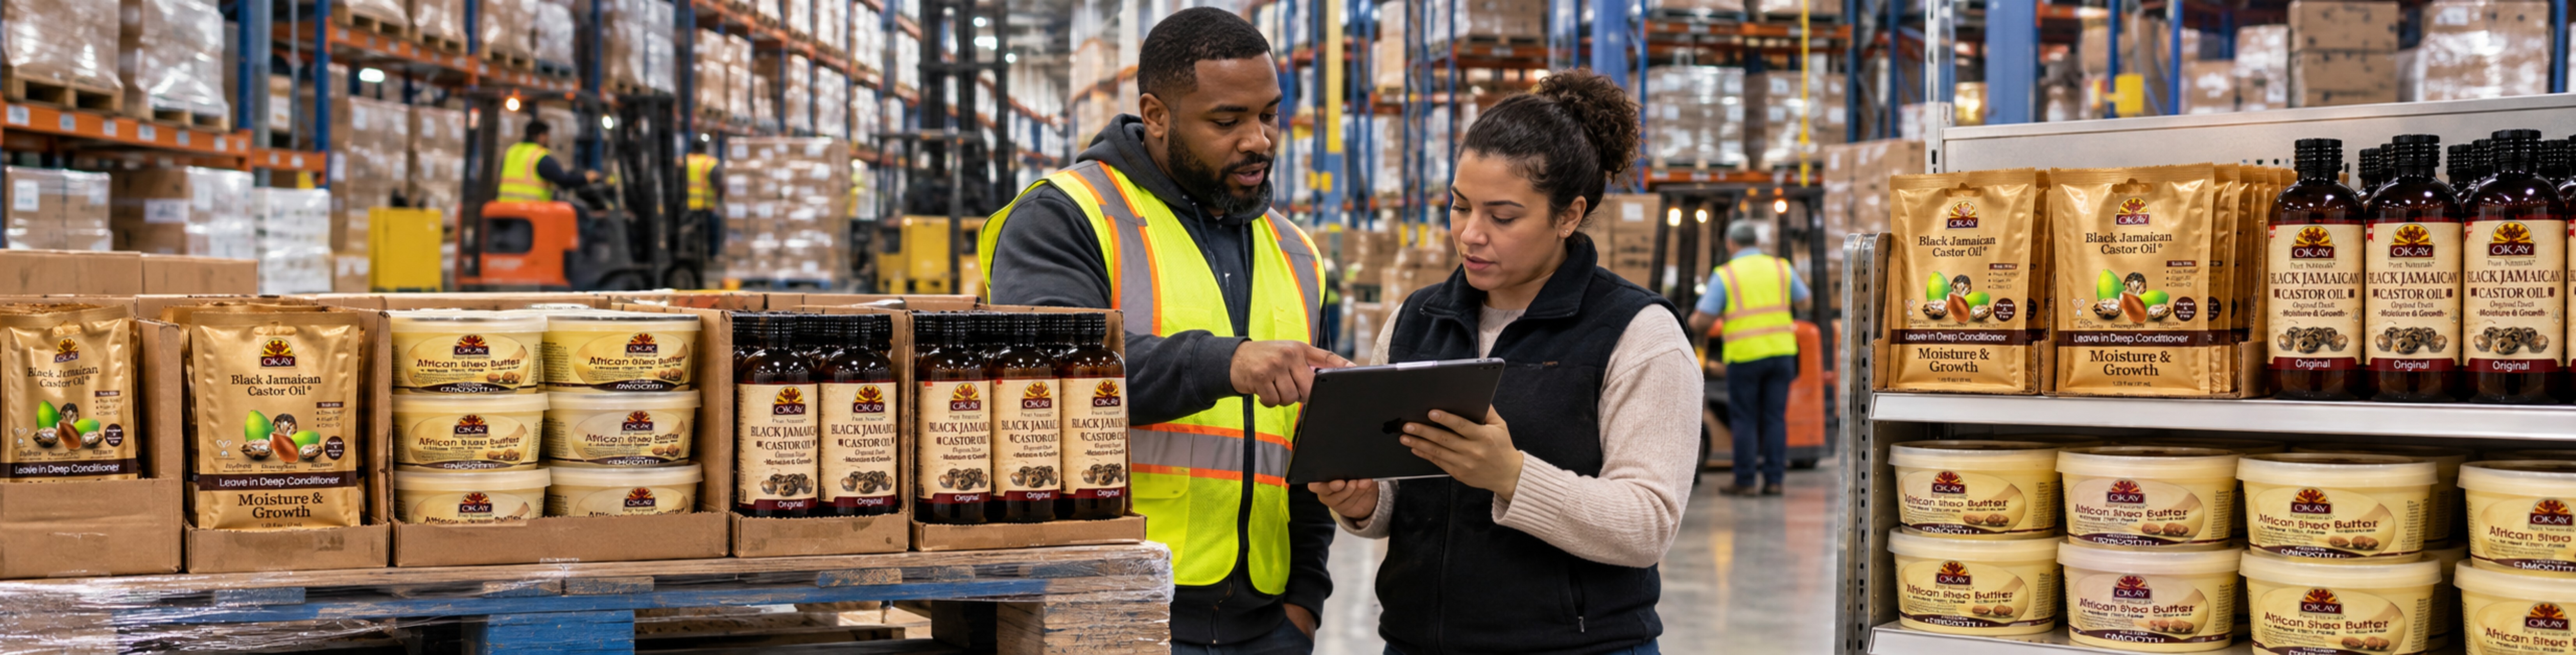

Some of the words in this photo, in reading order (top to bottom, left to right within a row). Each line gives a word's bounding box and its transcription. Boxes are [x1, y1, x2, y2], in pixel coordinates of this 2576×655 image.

[1918, 236, 1948, 246] Black
[1950, 235, 1996, 246] Jamaican
[2085, 233, 2117, 243] Black
[2119, 232, 2172, 243] Jamaican
[1932, 248, 1965, 257] Castor
[2100, 244, 2138, 255] Castor
[2294, 248, 2331, 257] OKAY
[2393, 247, 2430, 256] OKAY
[2491, 245, 2530, 254] OKAY
[2302, 272, 2359, 287] JAMAICAN
[2400, 272, 2458, 287] JAMAICAN
[2500, 269, 2561, 285] JAMAICAN
[2282, 289, 2325, 299] CASTOR
[2327, 289, 2346, 299] OIL
[2380, 289, 2424, 299] CASTOR
[2426, 289, 2445, 299] OIL
[2479, 287, 2525, 299] CASTOR
[2526, 287, 2546, 299] OIL
[1928, 332, 1935, 341] in
[1958, 332, 2007, 342] Conditioner
[2074, 333, 2099, 343] Leave
[2100, 333, 2109, 342] in
[2110, 334, 2134, 345] Deep
[2135, 333, 2189, 343] Conditioner
[1918, 348, 1977, 360] Moisture
[1979, 348, 1990, 360] &
[2089, 350, 2157, 363] Moisture
[2159, 351, 2171, 363] &
[263, 358, 292, 366] OKAY
[1929, 361, 1978, 373] Growth
[2295, 359, 2331, 369] Original
[2394, 360, 2429, 371] Original
[2493, 361, 2530, 372] Original
[2103, 364, 2159, 377] Growth
[39, 378, 71, 388] Castor
[231, 374, 263, 385] Black
[265, 374, 322, 385] Jamaican
[247, 386, 286, 397] Castor
[751, 426, 781, 437] BLACK
[831, 424, 860, 435] BLACK
[765, 441, 801, 450] CASTOR
[845, 438, 879, 448] CASTOR
[942, 436, 976, 446] CASTOR
[219, 477, 247, 487] Leave
[249, 477, 258, 486] in
[260, 477, 285, 487] Deep
[286, 476, 340, 485] Conditioner
[237, 493, 309, 506] Moisture
[311, 492, 324, 504] &
[251, 505, 311, 519] Growth
[2294, 504, 2328, 512] OKAY
[2533, 515, 2569, 524] OKAY
[2489, 525, 2533, 540] African
[2304, 604, 2337, 613] OKAY
[2528, 619, 2565, 628] OKAY
[2485, 627, 2529, 643] African
